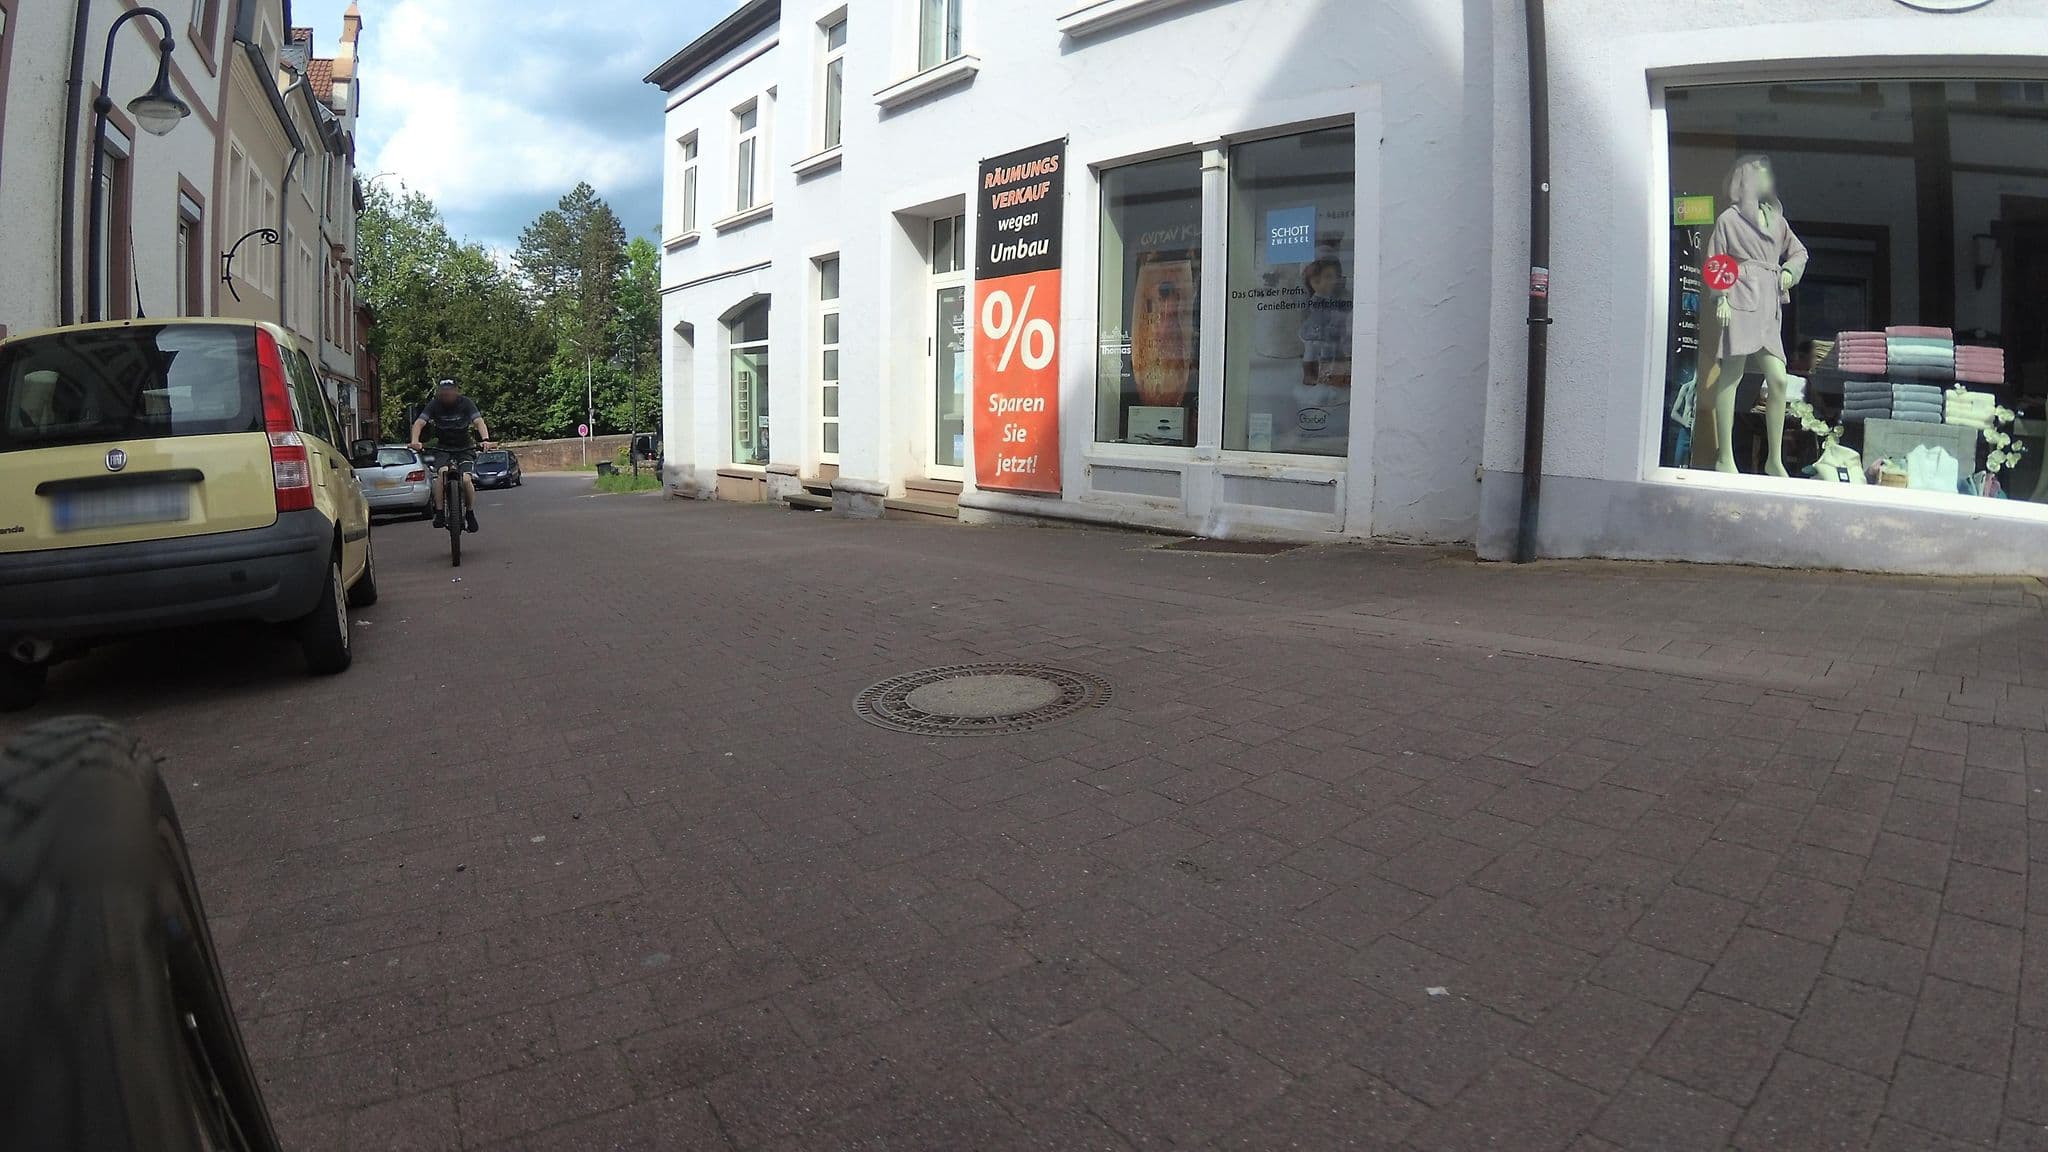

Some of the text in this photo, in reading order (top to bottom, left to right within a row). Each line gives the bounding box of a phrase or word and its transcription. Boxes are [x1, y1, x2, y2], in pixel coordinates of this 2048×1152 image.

[984, 155, 1059, 189] RÄUMUNGS
[991, 181, 1051, 210] VERKAUF
[998, 212, 1039, 232] wegen
[1271, 225, 1310, 238] SCHOTT
[990, 238, 1049, 263] Umbau
[1271, 236, 1309, 246] ZWIESEL
[1231, 290, 1246, 299] Das
[1248, 289, 1265, 298] Glas
[1267, 287, 1280, 297] der
[1257, 301, 1296, 311] Genießen
[1297, 300, 1306, 309] in
[982, 285, 1055, 372] %
[1101, 346, 1132, 355] Thomas
[988, 394, 1045, 416] Sparen
[1003, 423, 1027, 443] Sie
[996, 454, 1037, 476] jetzt!
[0, 525, 25, 535] anda
